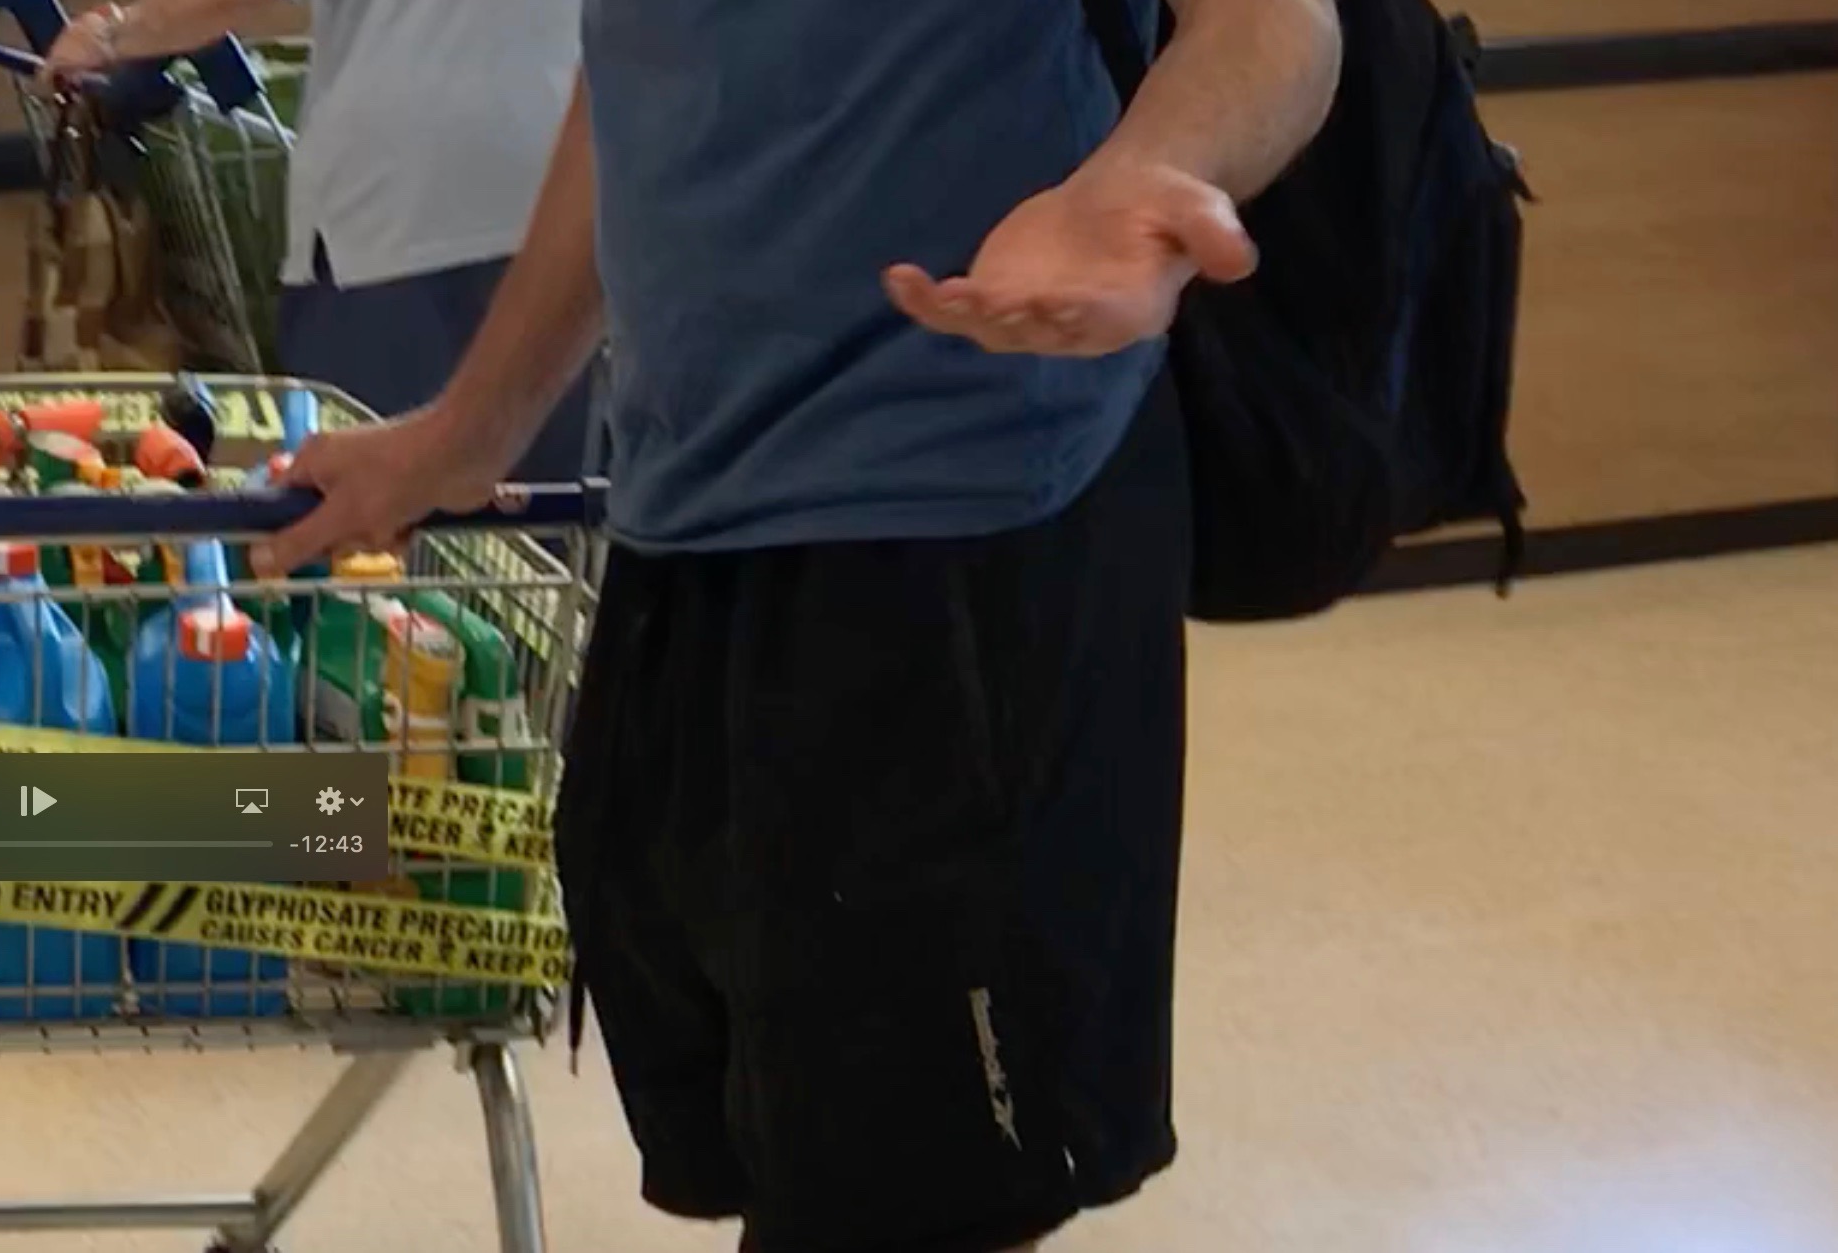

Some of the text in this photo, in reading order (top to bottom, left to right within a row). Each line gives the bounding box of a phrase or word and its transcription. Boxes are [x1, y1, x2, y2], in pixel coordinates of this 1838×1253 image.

[12, 882, 125, 919] ENTRY
[206, 887, 386, 931] GLYPHOSATE
[200, 918, 305, 951] CAUSES
[313, 931, 423, 964] CANCER
[464, 948, 534, 977] KEEP
